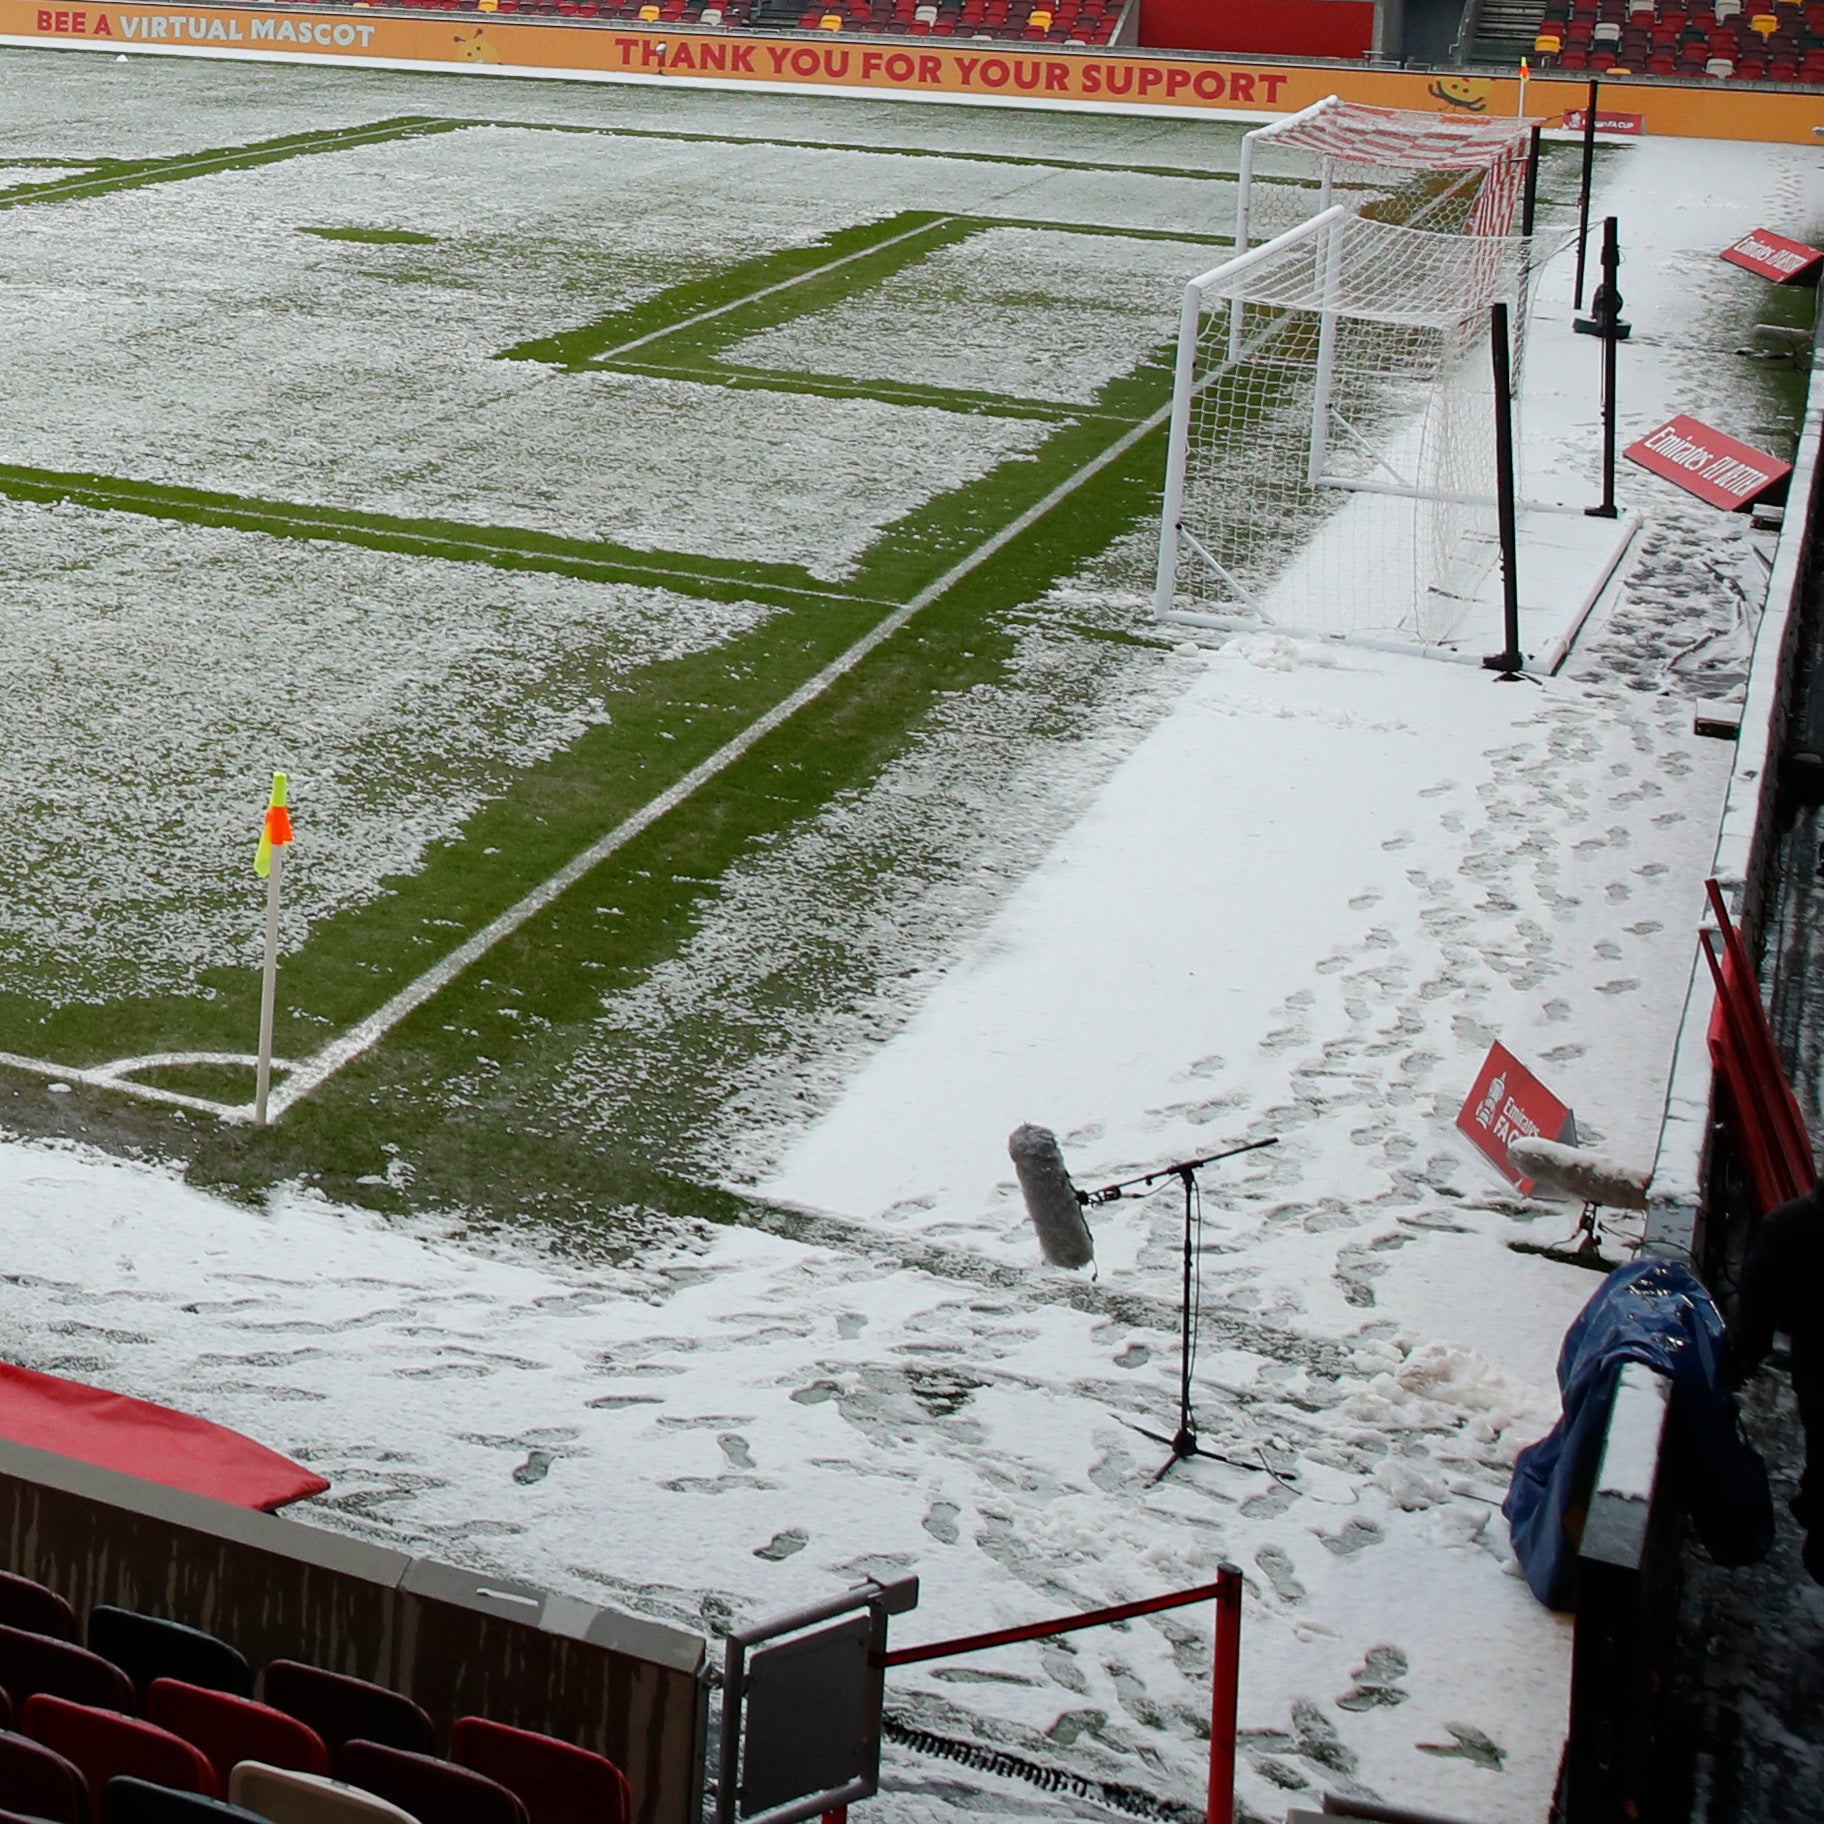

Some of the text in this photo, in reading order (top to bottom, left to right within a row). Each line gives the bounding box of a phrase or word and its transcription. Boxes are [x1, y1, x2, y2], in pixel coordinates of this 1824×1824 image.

[36, 10, 376, 48] BEE A VIRTUAL MASCOT
[614, 38, 1288, 104] THANK YOU FOR YOUR SUPPORT
[1644, 426, 1714, 471] Emirates
